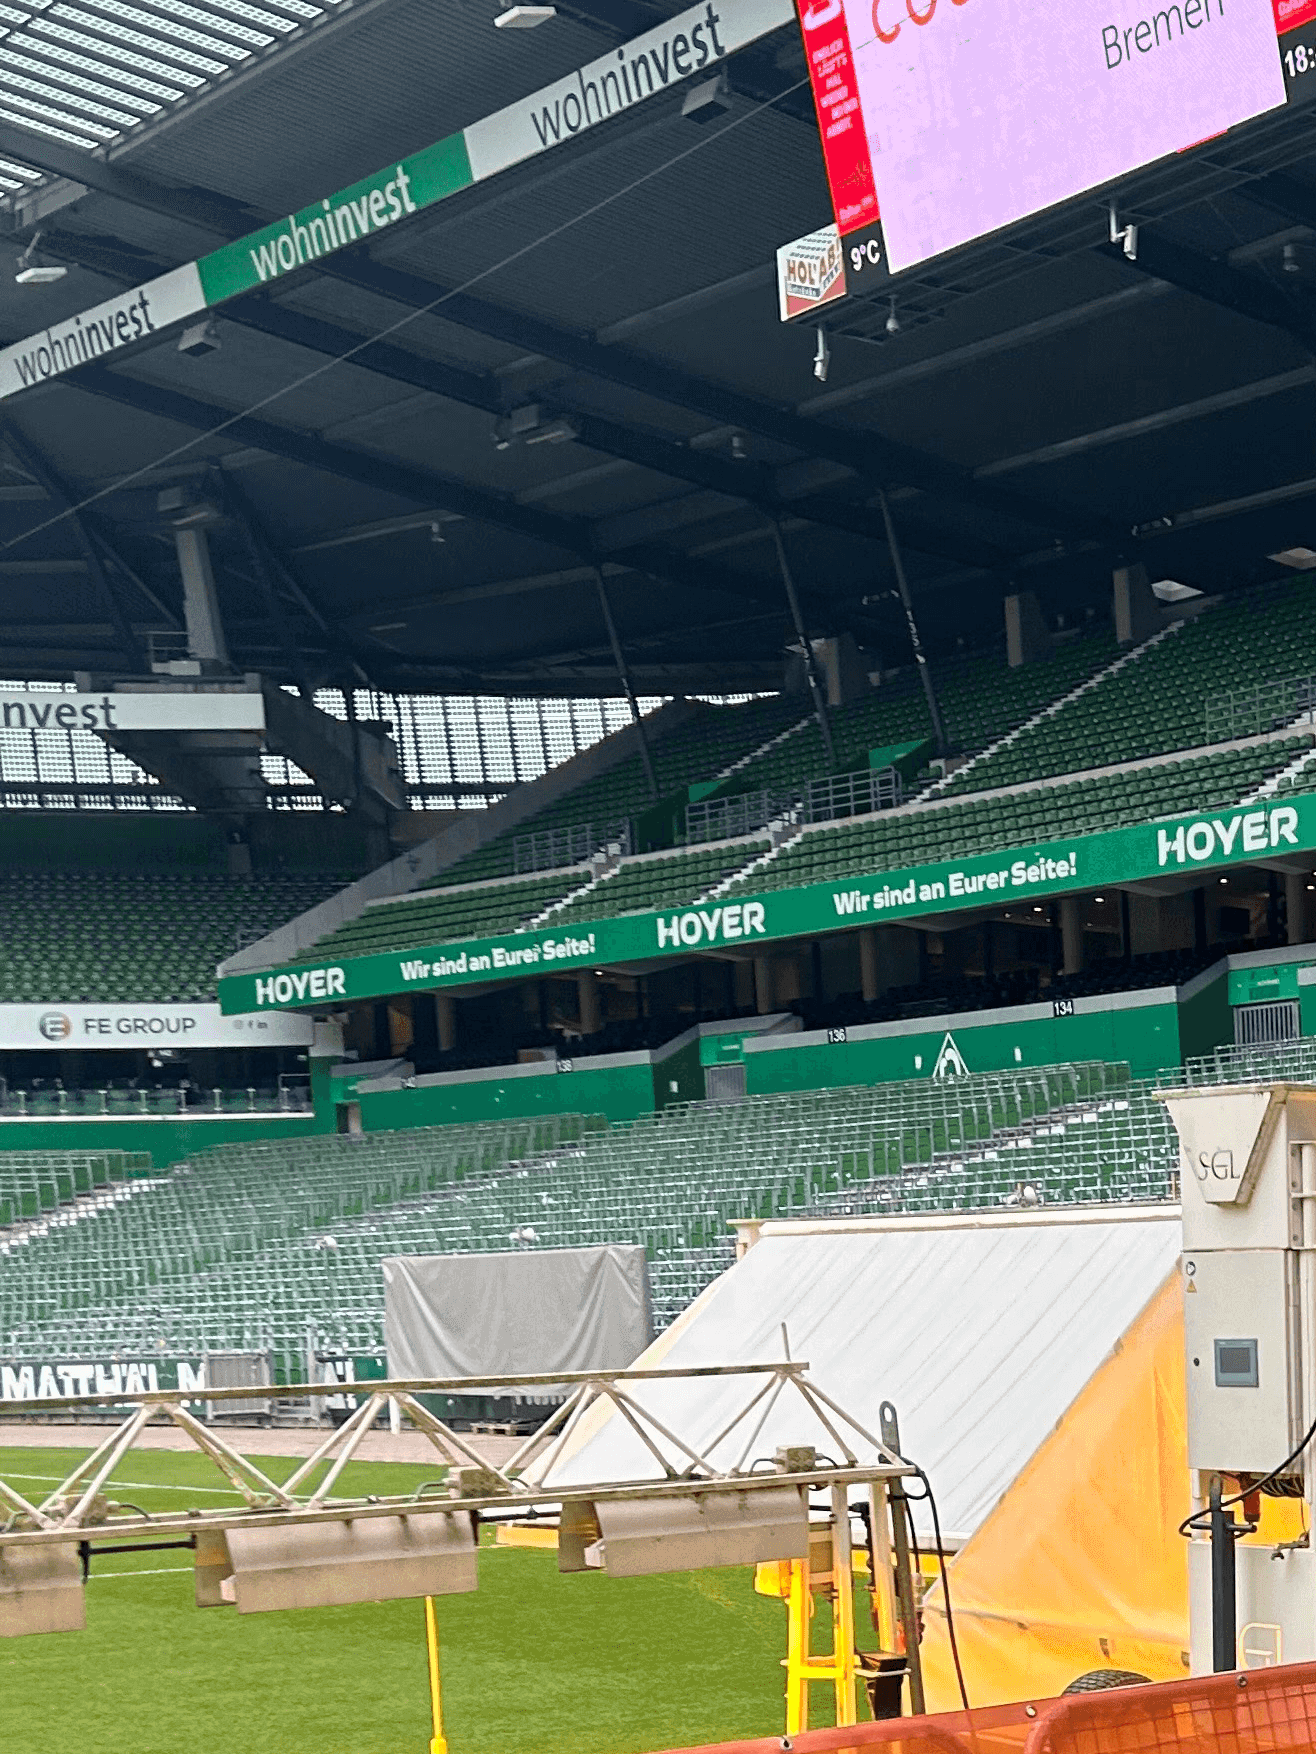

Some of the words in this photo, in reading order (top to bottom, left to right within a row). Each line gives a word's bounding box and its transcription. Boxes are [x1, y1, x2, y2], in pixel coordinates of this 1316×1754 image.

[531, 4, 726, 148] wohninvest
[250, 166, 417, 281] wohninvest
[851, 240, 880, 271] 9°C
[14, 289, 155, 387] wohninvest
[1157, 806, 1299, 866] HOYER
[833, 890, 870, 914] Wir
[873, 879, 916, 909] sind
[919, 882, 945, 901] an
[948, 869, 1009, 896] Eurer
[1011, 852, 1077, 885] Seite!
[656, 902, 766, 948] HOYER
[400, 960, 430, 981] Wir
[432, 952, 467, 975] sind
[469, 953, 490, 971] an
[543, 934, 595, 960] Seite!
[255, 967, 346, 1005] HOYER
[1054, 1000, 1073, 1016] 134
[84, 1018, 112, 1034] FE
[116, 1017, 197, 1034] GROUP
[1198, 1150, 1241, 1181] SGL
